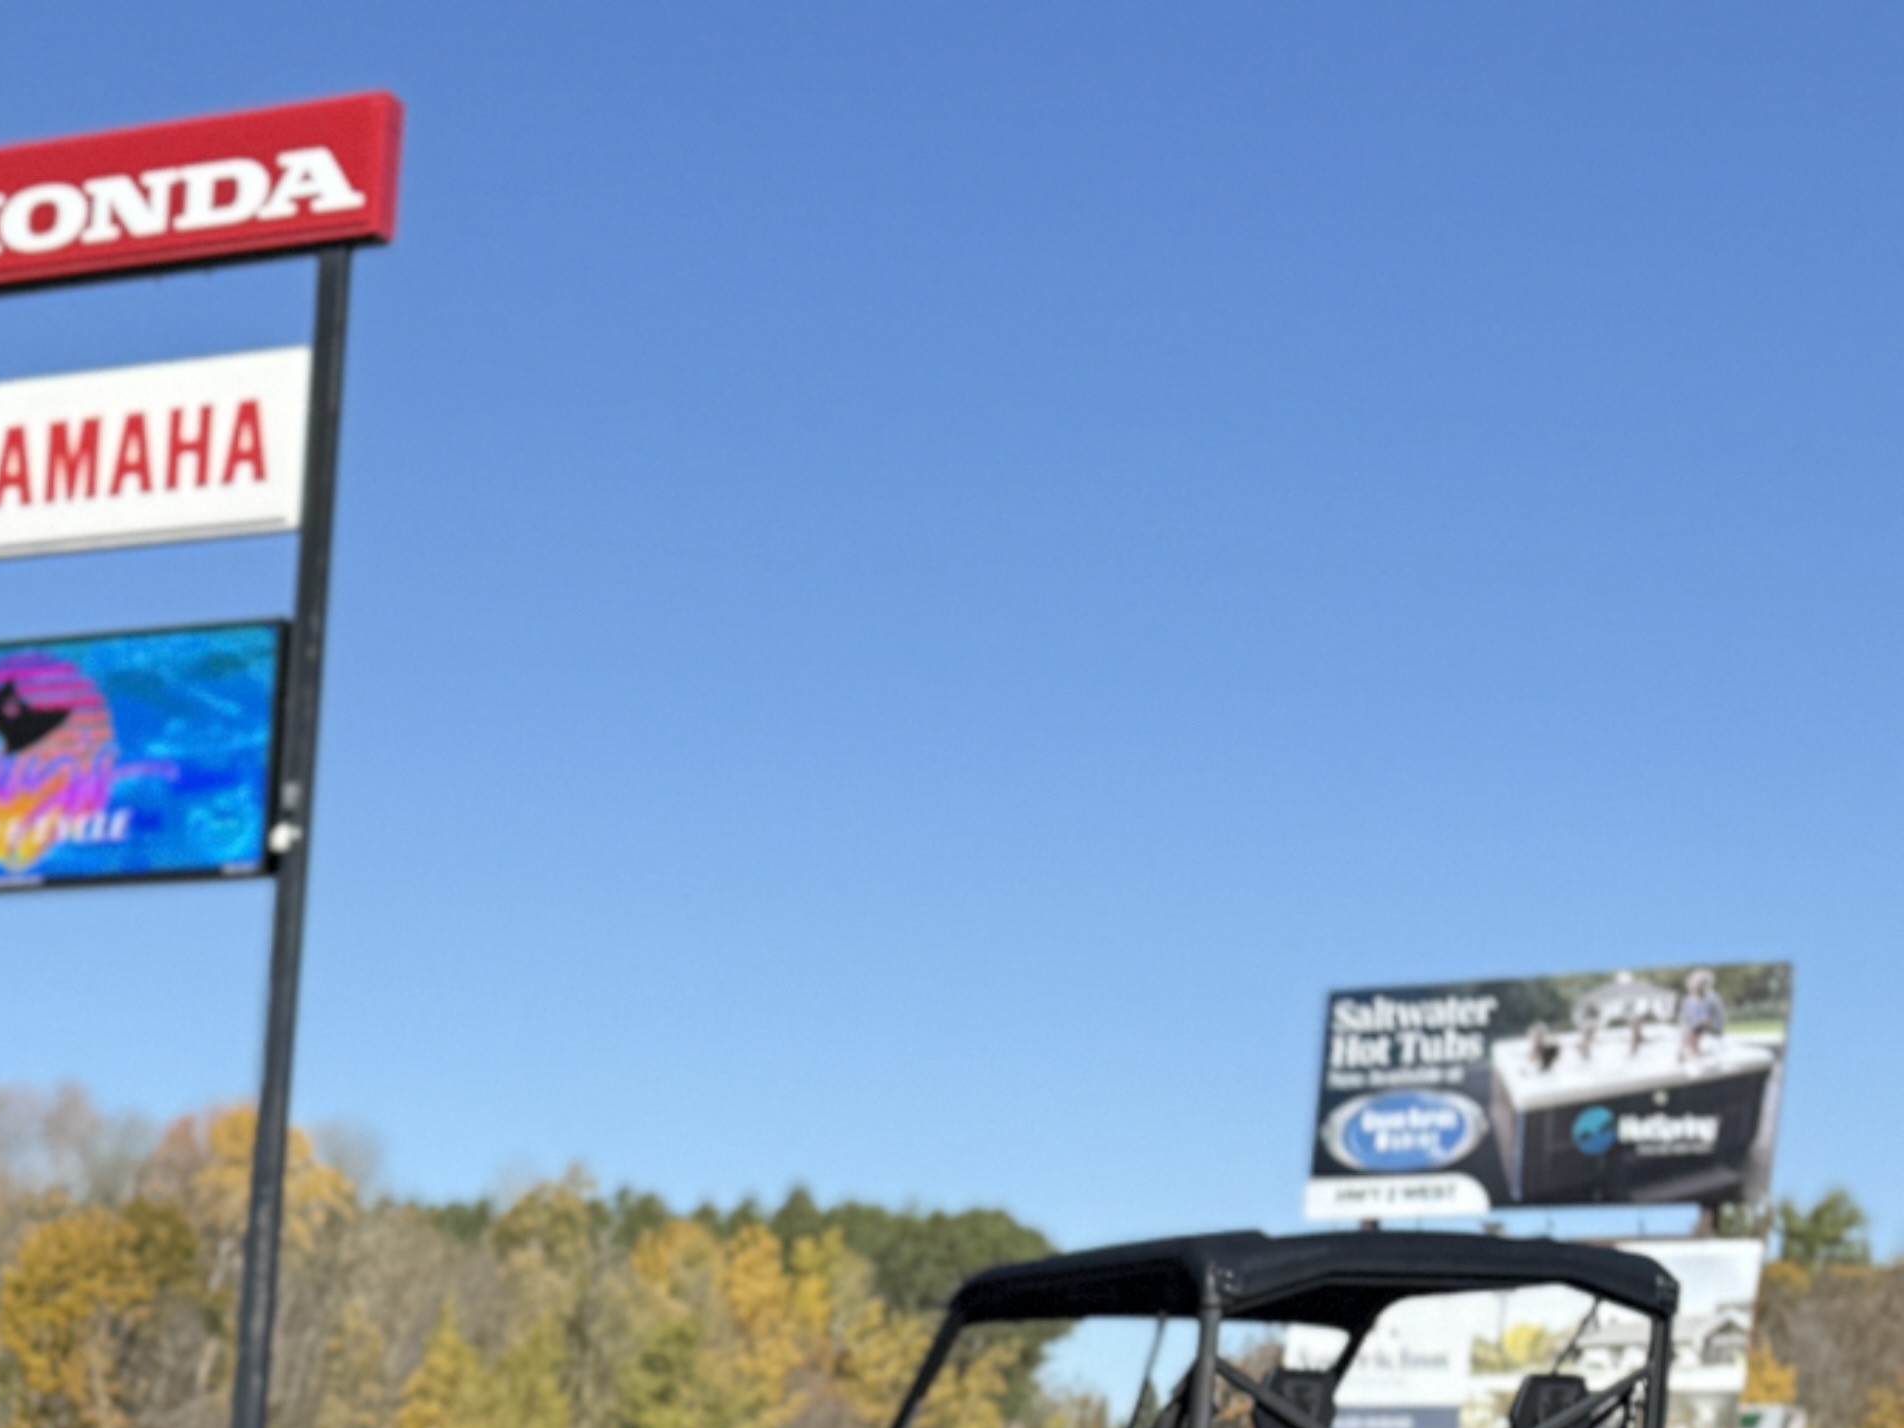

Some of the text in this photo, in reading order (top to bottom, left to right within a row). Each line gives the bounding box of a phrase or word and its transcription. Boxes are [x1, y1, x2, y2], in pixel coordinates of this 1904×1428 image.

[1332, 994, 1498, 1032] Saltwater
[1330, 1028, 1485, 1069] Hot Tubs
